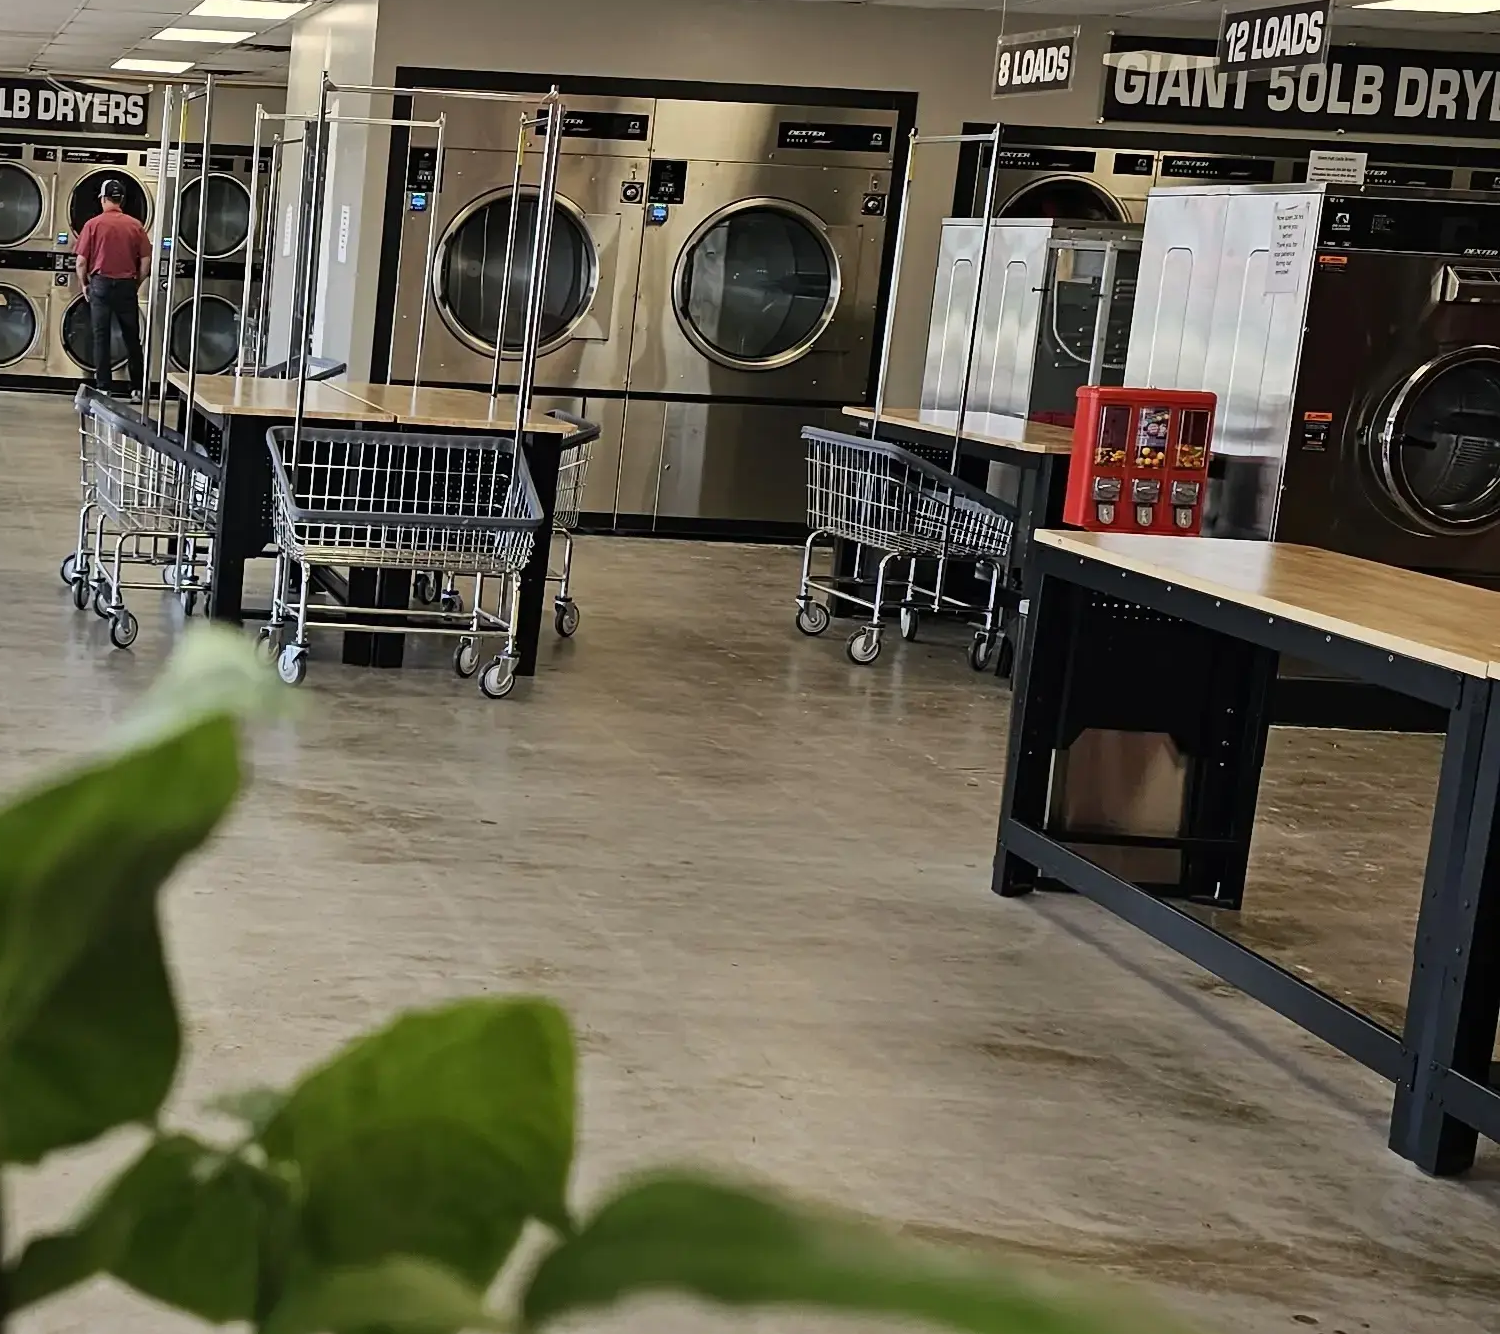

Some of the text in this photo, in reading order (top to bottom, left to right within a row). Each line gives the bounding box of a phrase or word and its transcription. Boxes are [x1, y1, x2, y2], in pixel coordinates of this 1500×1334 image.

[1226, 10, 1324, 63] 12 LOADS
[998, 45, 1070, 87] 8 LOADS
[37, 90, 144, 126] DRYERS
[1267, 63, 1385, 116] 50LB
[1171, 159, 1210, 167] DEXTER
[1463, 248, 1499, 256] DEXTER
